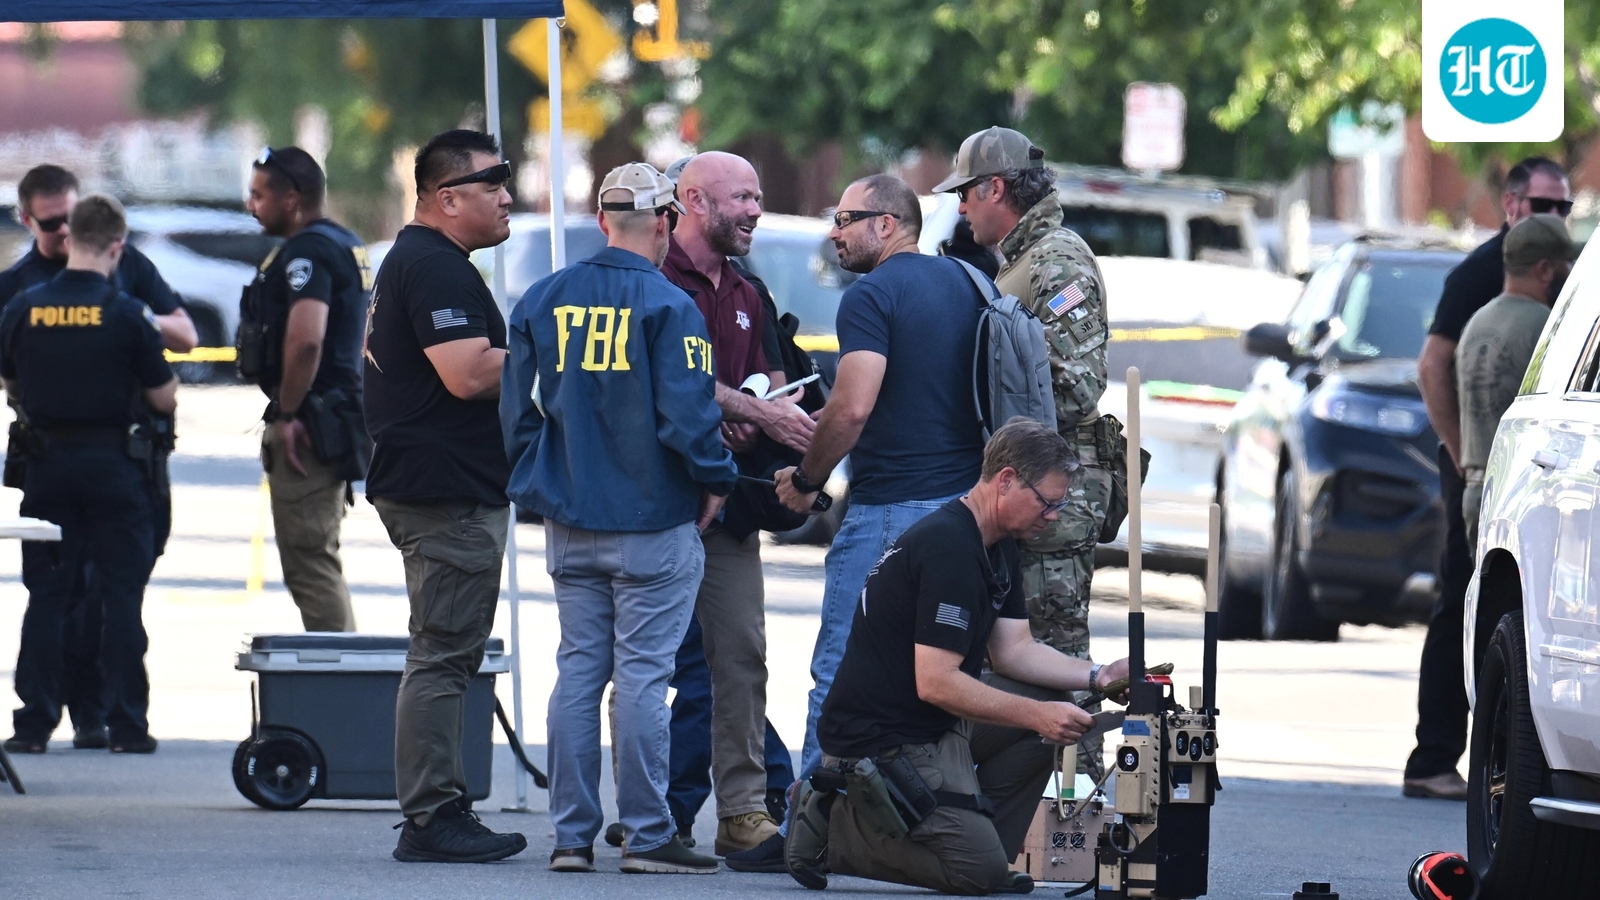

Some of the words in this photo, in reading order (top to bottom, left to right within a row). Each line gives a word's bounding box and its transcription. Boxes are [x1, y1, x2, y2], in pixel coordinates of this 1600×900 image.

[30, 306, 102, 327] POLICE
[553, 305, 632, 373] FBI
[683, 336, 713, 376] FBI
